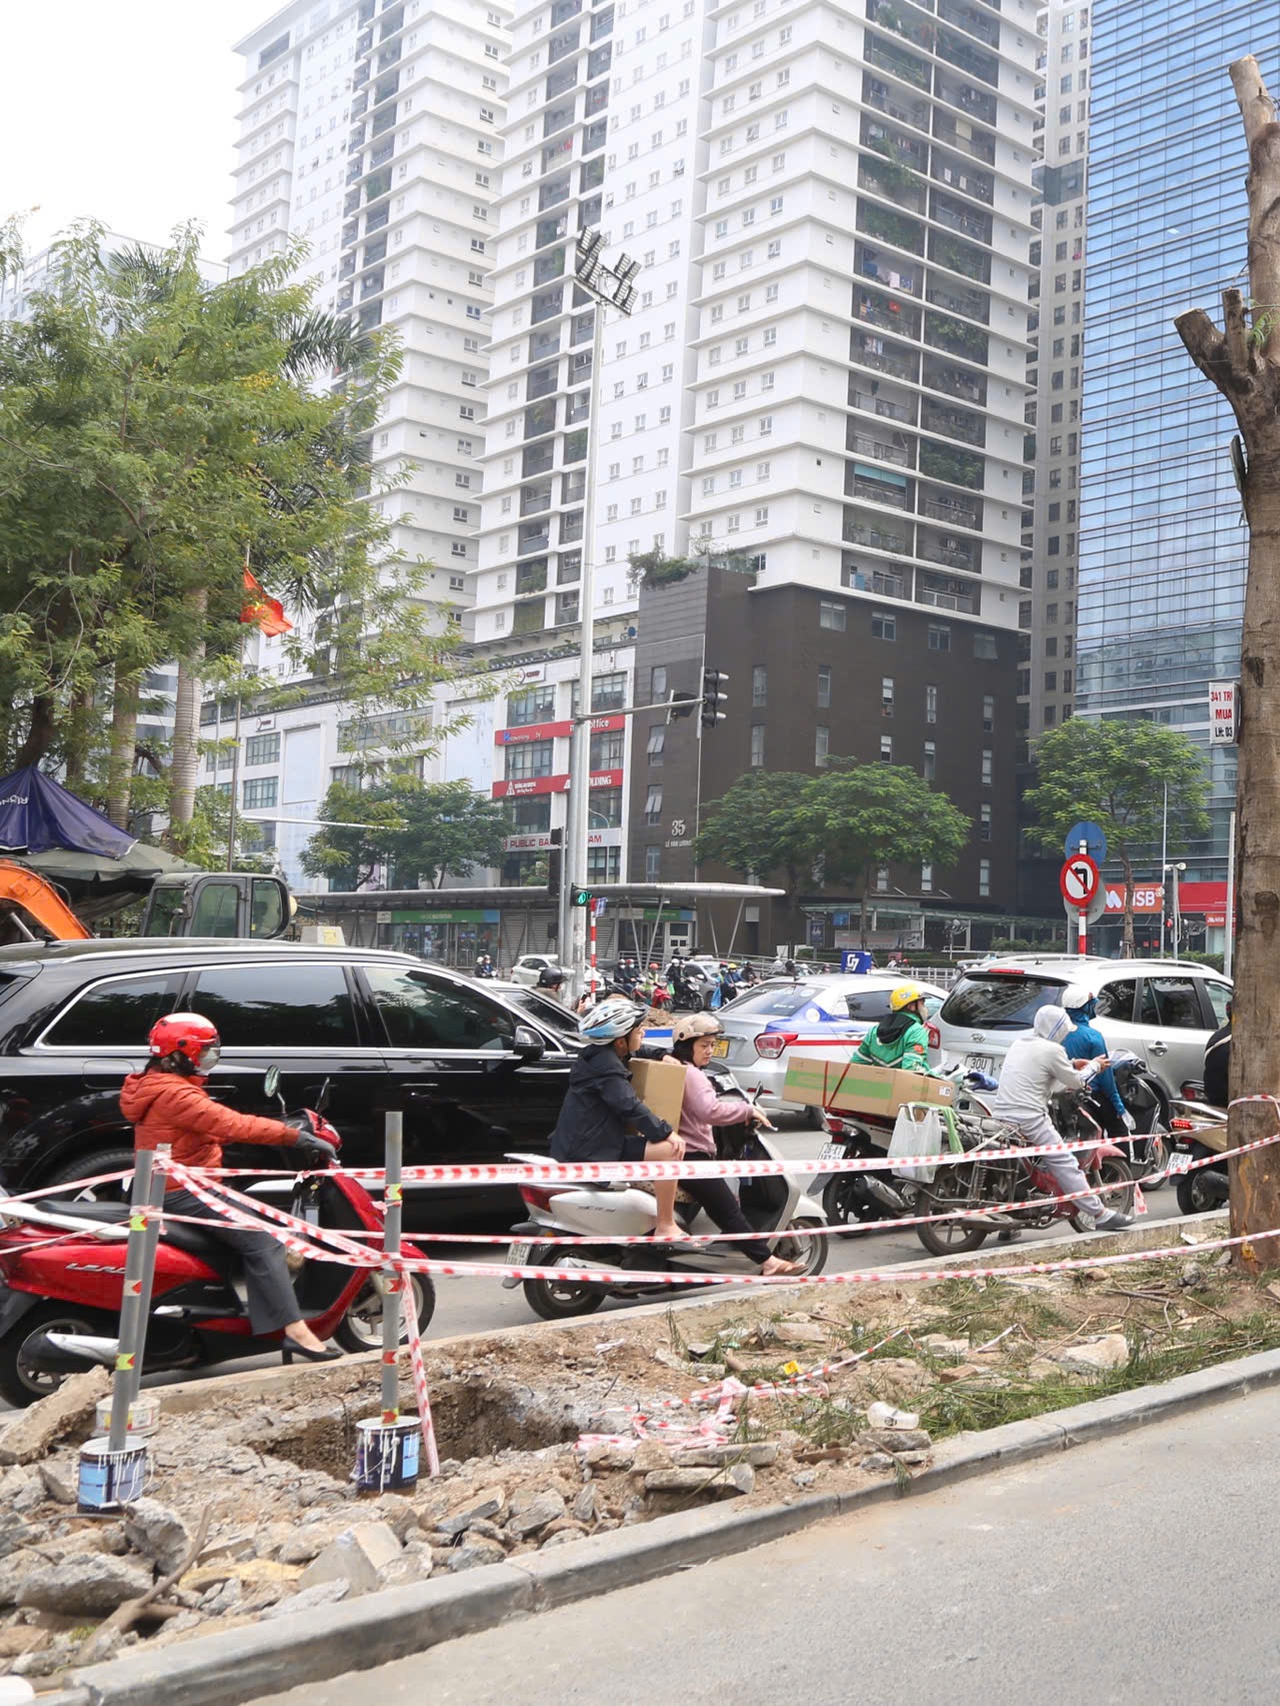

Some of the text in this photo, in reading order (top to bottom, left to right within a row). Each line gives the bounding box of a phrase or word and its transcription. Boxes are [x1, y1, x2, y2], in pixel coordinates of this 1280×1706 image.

[1210, 691, 1222, 701] 341
[1215, 708, 1233, 719] MUA
[671, 819, 686, 836] 35
[510, 838, 536, 848] PUBLIC
[846, 953, 860, 971] G7
[970, 1058, 988, 1070] 30U
